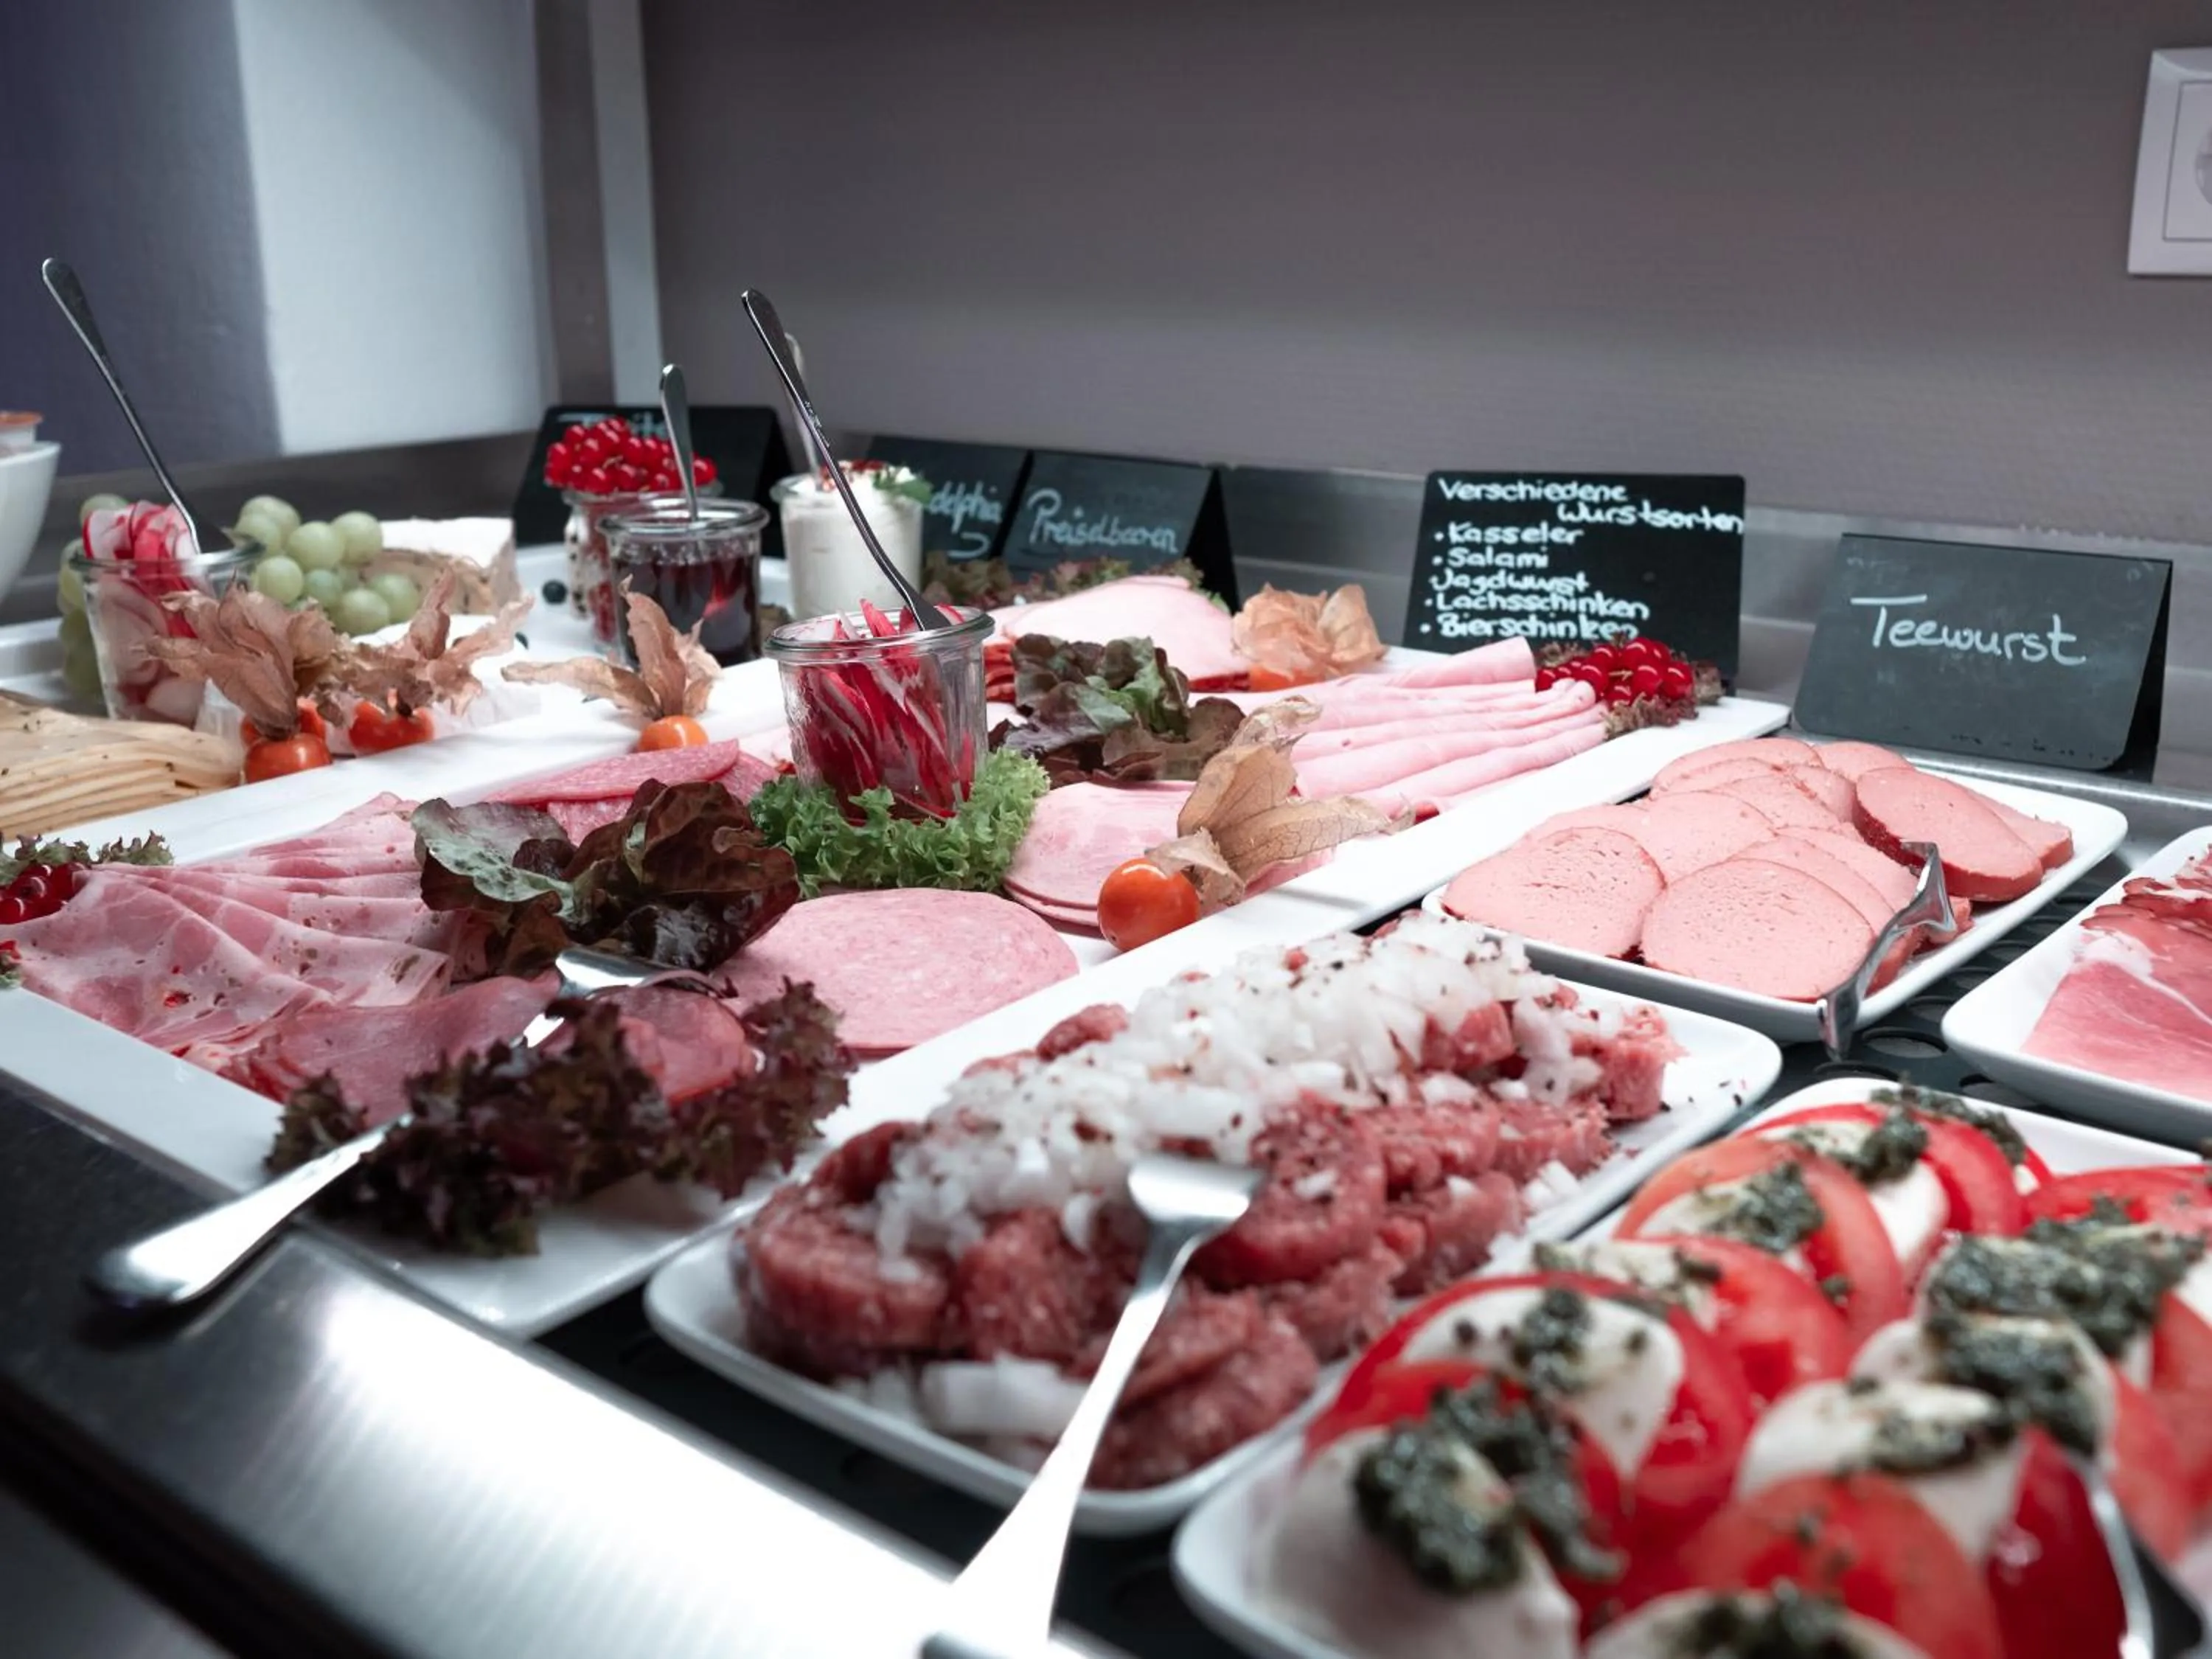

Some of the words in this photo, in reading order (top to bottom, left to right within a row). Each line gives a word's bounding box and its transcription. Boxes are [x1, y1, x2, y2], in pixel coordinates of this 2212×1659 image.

[1439, 478, 1627, 504] Verschiedene
[928, 480, 1002, 535] delphia
[1448, 521, 1585, 545] Kasseler
[1447, 546, 1548, 568] Salami
[1433, 567, 1590, 595] Jagdwurst
[1436, 590, 1650, 620] Lachsschinken
[1436, 611, 1639, 641] Bierschinken
[1850, 594, 2087, 665] Teewurst
